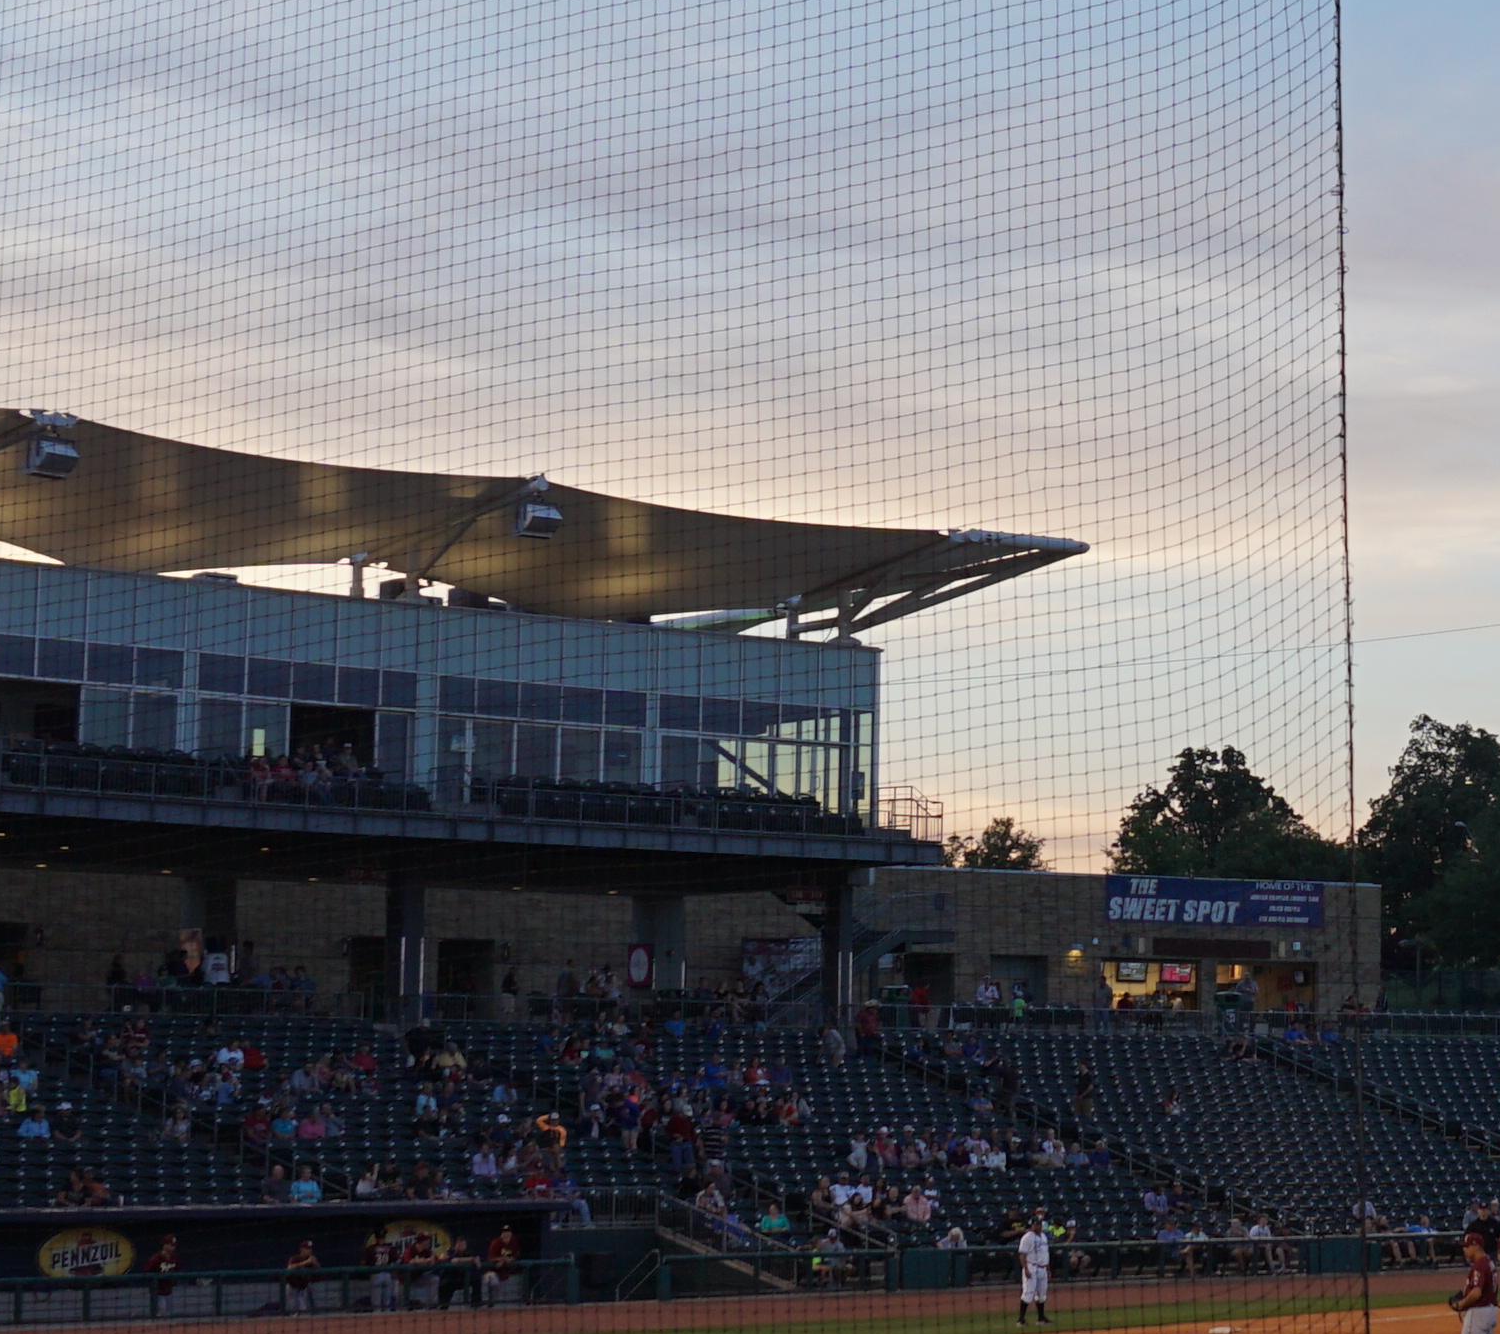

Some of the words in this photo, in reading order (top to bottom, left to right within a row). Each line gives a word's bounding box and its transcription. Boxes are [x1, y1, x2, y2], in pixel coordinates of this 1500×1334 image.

[1130, 878, 1159, 895] THE
[1109, 896, 1181, 921] SWEET
[1183, 899, 1241, 924] SPOT
[51, 1241, 122, 1270] PENNZOIL
